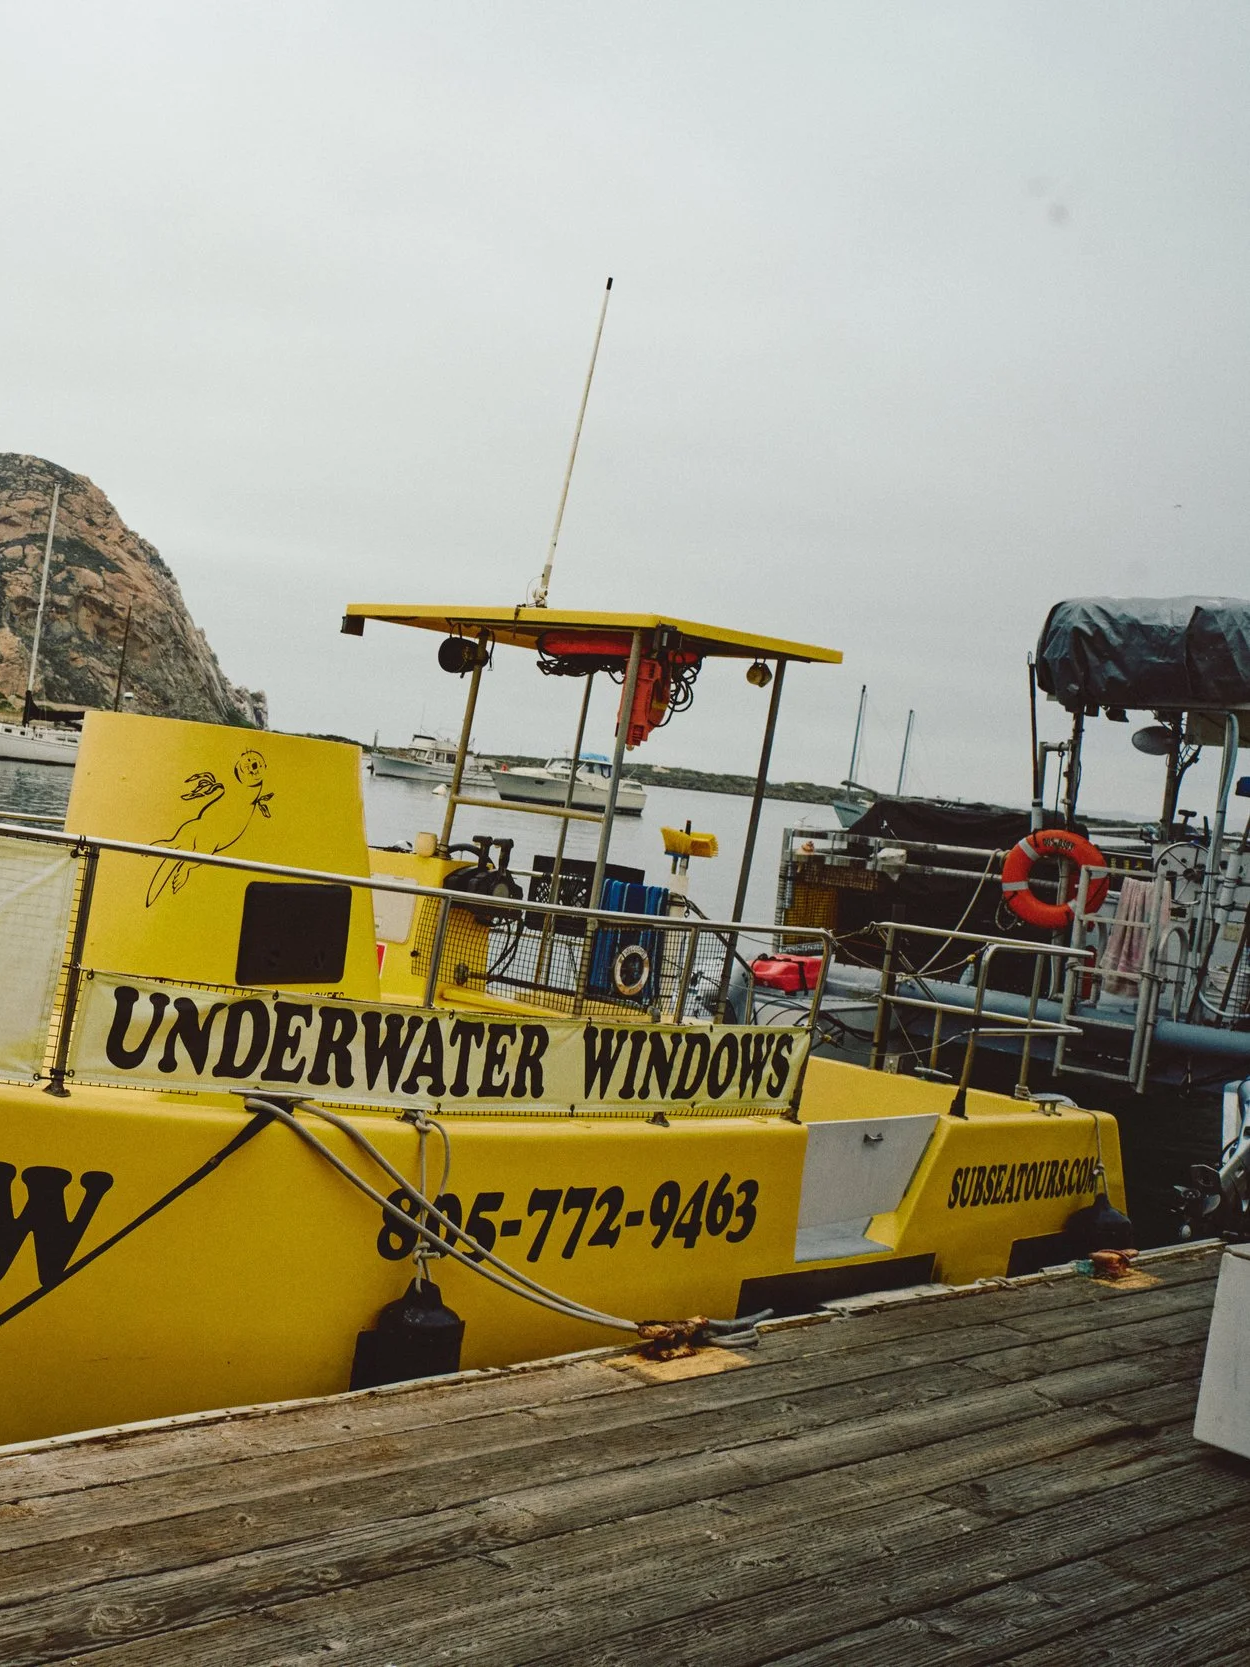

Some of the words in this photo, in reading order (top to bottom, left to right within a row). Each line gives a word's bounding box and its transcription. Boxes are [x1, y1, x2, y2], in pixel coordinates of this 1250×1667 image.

[106, 986, 550, 1098] UNDERWATER
[584, 1024, 794, 1101] WINDOWS
[377, 1173, 759, 1263] 805-772-9463
